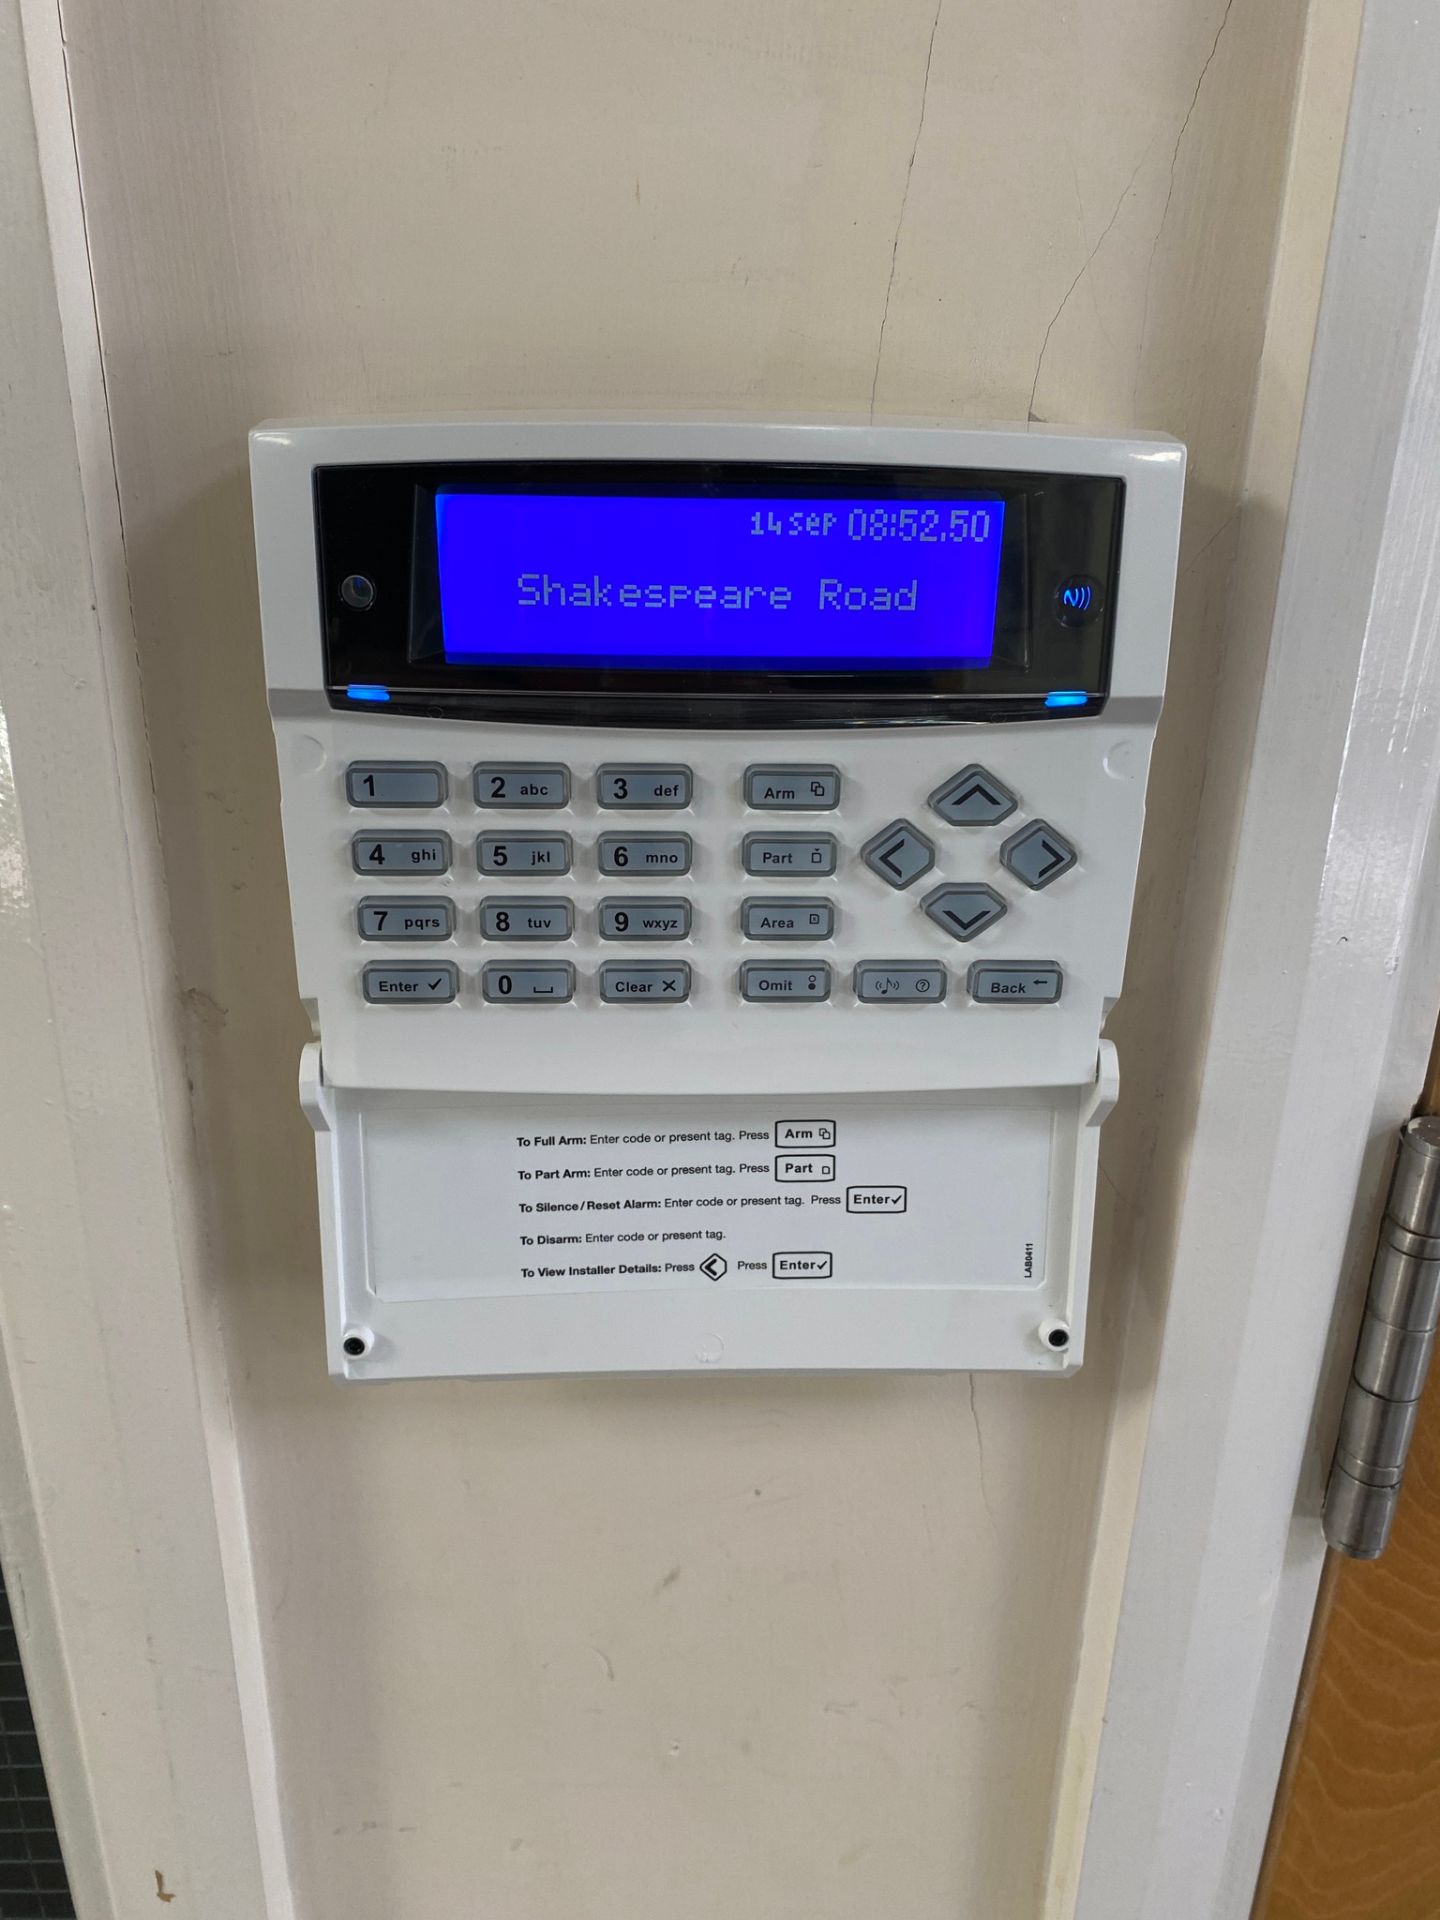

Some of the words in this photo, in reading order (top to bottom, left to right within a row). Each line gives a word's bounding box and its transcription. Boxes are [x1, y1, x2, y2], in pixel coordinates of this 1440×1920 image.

[750, 511, 782, 536] 14
[517, 573, 792, 610] Shakespeare
[818, 578, 918, 611] Road
[363, 774, 375, 797] 1
[490, 776, 506, 799] 2
[519, 783, 549, 796] abc
[613, 777, 629, 800] 3
[653, 784, 679, 797] def
[763, 787, 795, 800] Arm
[368, 843, 386, 865] 4
[410, 848, 436, 864] ghi
[493, 845, 508, 867] 5
[530, 850, 551, 866] jkl
[613, 846, 629, 867] 6
[645, 854, 679, 864] mno
[762, 851, 793, 864] Part
[373, 910, 389, 932] 7
[404, 918, 440, 931] pqrs
[495, 911, 511, 932] 8
[527, 917, 552, 929] tuv
[614, 911, 629, 933] 9
[642, 919, 678, 931] wxyz
[760, 917, 794, 929] Area
[378, 980, 419, 993] Enter
[498, 974, 513, 995] 0
[615, 981, 653, 993] Clear
[758, 979, 793, 991] Omit
[990, 982, 1026, 994] Back
[516, 1136, 531, 1147] To
[533, 1135, 556, 1147] Full
[558, 1135, 587, 1146] Arm:
[589, 1134, 620, 1145] Enter
[622, 1132, 652, 1144] code
[653, 1134, 667, 1143] or
[668, 1131, 712, 1145] present
[713, 1131, 736, 1143] tag.
[738, 1130, 770, 1140] Press
[784, 1128, 813, 1139] Arm
[517, 1170, 532, 1181] To
[534, 1169, 561, 1180] Part
[562, 1168, 591, 1179] Arm:
[593, 1167, 624, 1178] Enter
[625, 1166, 654, 1177] code
[656, 1167, 669, 1176] or
[670, 1164, 713, 1178] present
[714, 1164, 736, 1176] tag.
[739, 1163, 770, 1174] Press
[784, 1162, 813, 1174] Part
[518, 1203, 533, 1213] To
[623, 1199, 662, 1209] Alarm:
[664, 1197, 694, 1208] Enter
[695, 1196, 724, 1207] code
[725, 1198, 738, 1207] or
[740, 1195, 782, 1208] present
[783, 1196, 805, 1208] tag.
[810, 1194, 842, 1205] Press
[853, 1193, 891, 1205] Enter
[519, 1235, 534, 1246] To
[536, 1235, 582, 1245] Disarm:
[585, 1233, 615, 1243] Enter
[616, 1231, 645, 1242] code
[647, 1233, 660, 1242] or
[661, 1230, 703, 1243] present
[705, 1230, 726, 1241] tag.
[520, 1267, 535, 1278] To
[537, 1267, 566, 1278] View
[568, 1265, 616, 1276] Installer
[618, 1263, 662, 1274] Details:
[664, 1262, 696, 1273] Press
[737, 1260, 768, 1271] Press
[779, 1260, 816, 1271] Enter
[1023, 1243, 1034, 1279] LAB0411
